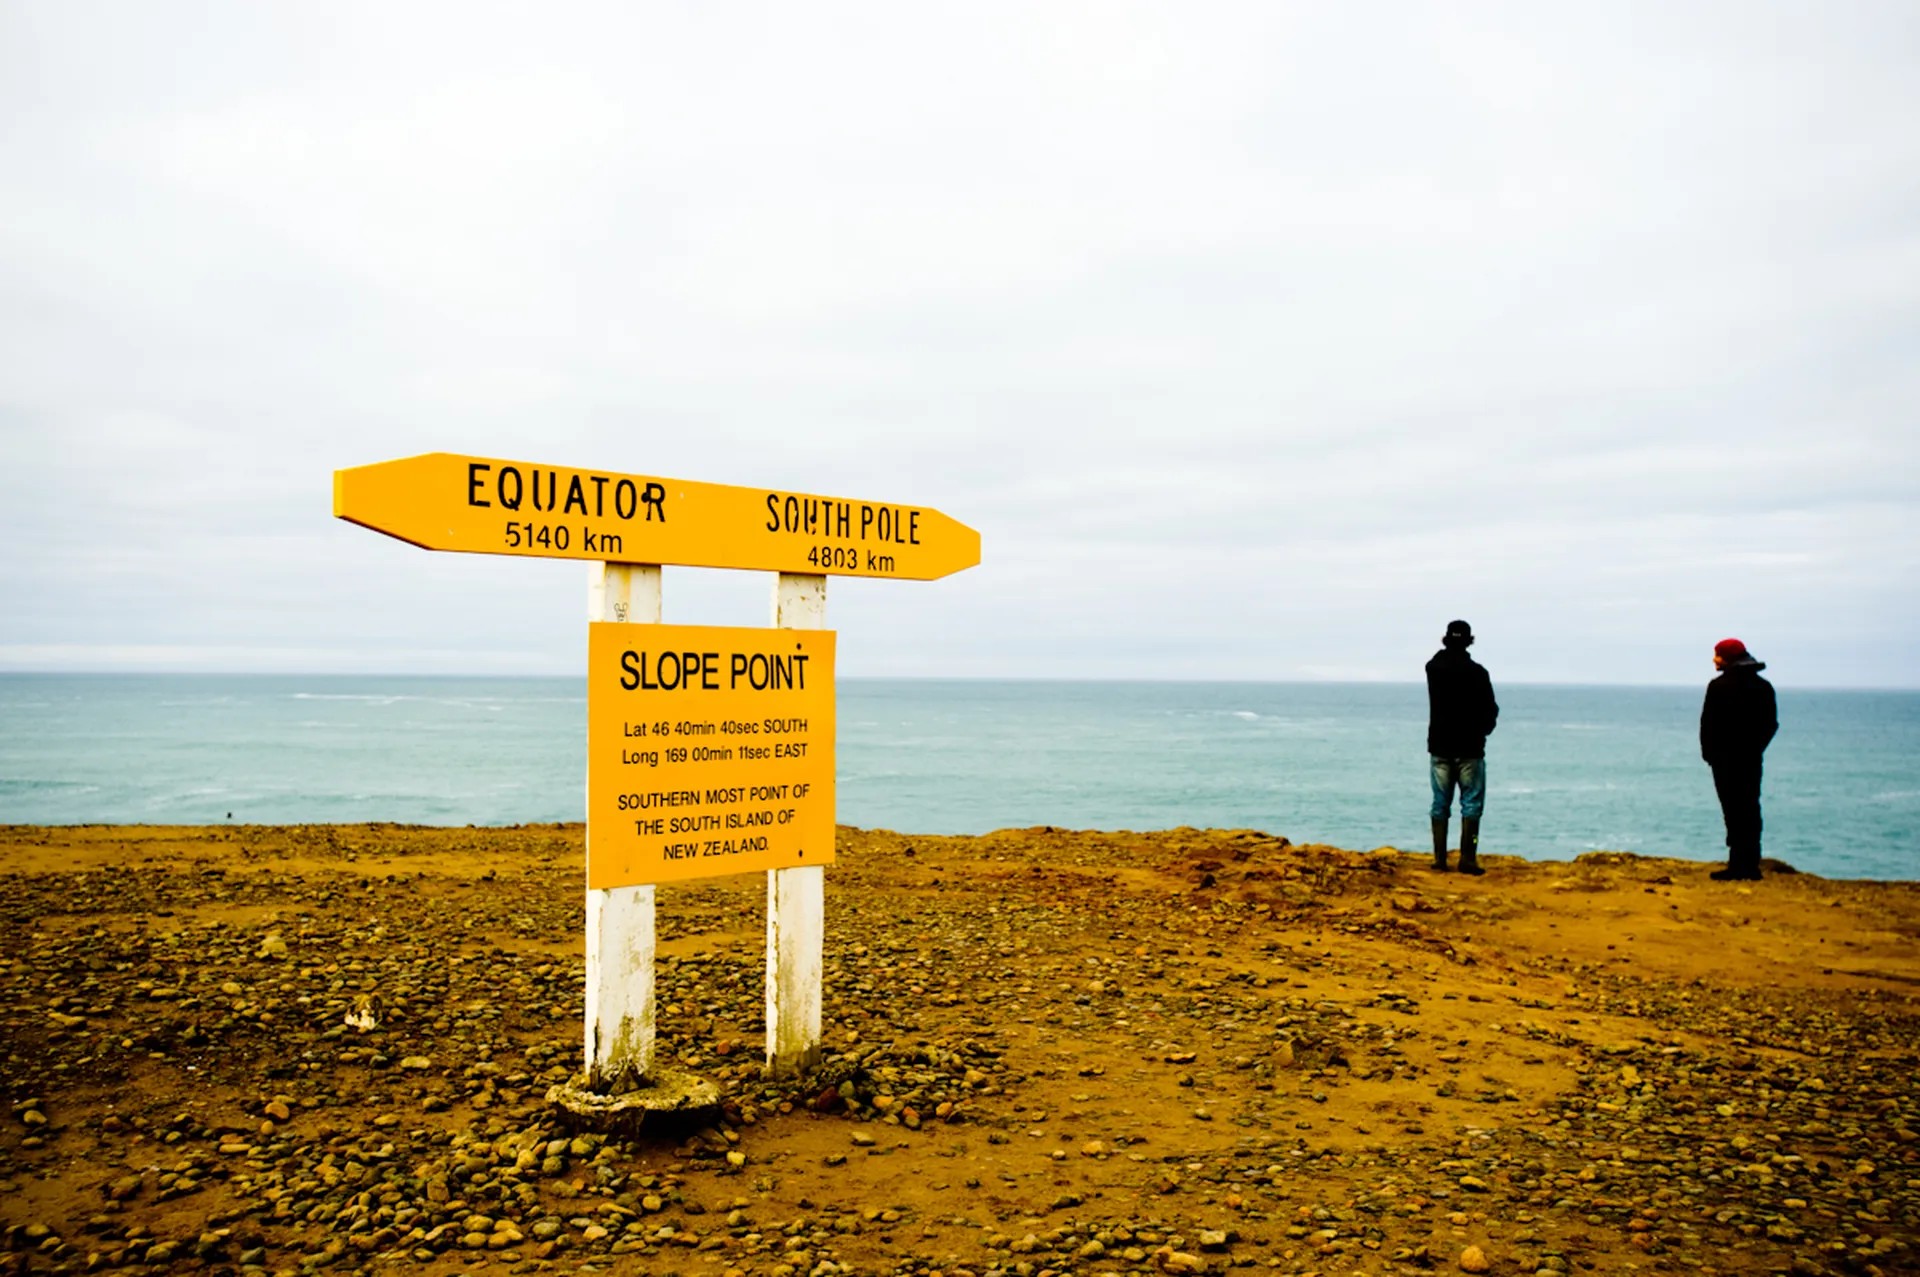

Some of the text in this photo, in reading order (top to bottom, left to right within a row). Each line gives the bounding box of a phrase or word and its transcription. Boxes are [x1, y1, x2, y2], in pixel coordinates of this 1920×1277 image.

[468, 463, 666, 523] EQUATOR
[766, 493, 921, 545] SOUTH POLE
[504, 521, 623, 554] 5140 km
[807, 546, 895, 572] 4803 km
[620, 650, 809, 691] SLOPE POINT
[624, 719, 808, 737] Lat 46 40min 40sec SOUTH
[622, 743, 808, 768] Long 169 00min 11sec EAST
[618, 783, 810, 811] SOUTHERN MOST POINT OF
[635, 808, 795, 836] THE SOUTH ISLAND OF
[663, 843, 699, 860] NEW
